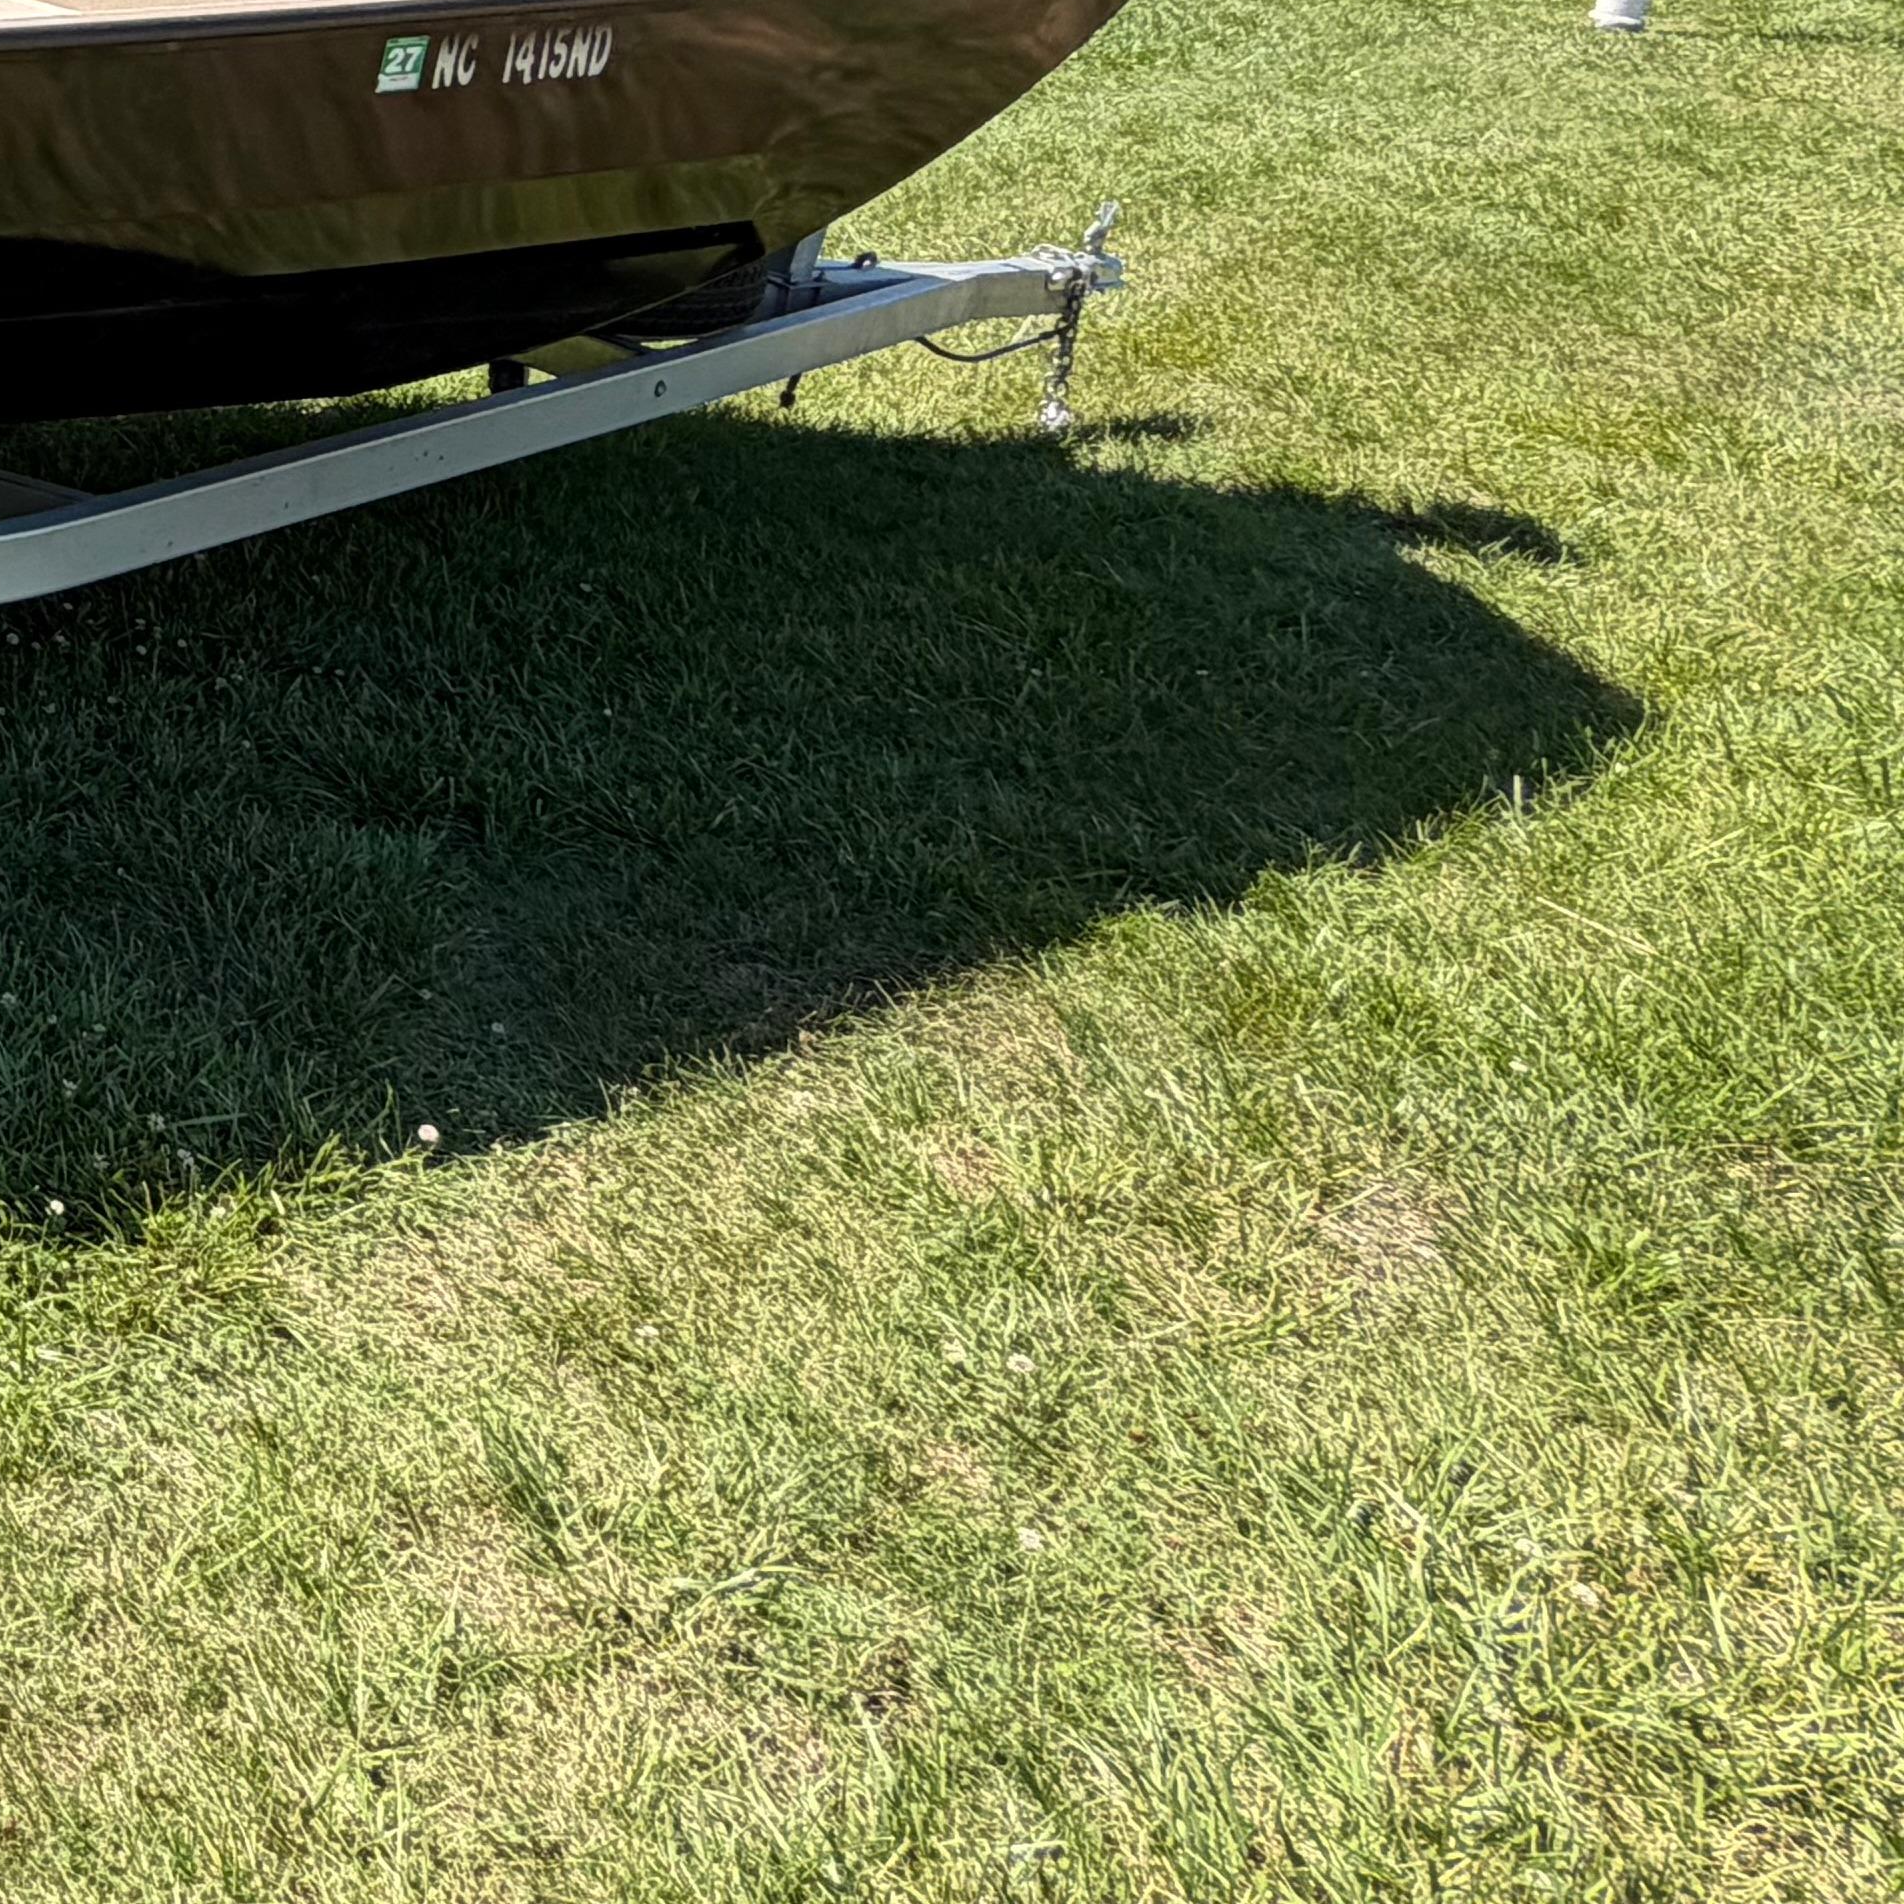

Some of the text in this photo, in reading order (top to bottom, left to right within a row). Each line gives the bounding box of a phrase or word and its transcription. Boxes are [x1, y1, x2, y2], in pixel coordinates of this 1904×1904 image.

[385, 25, 613, 90] 27 NC 1415ND
